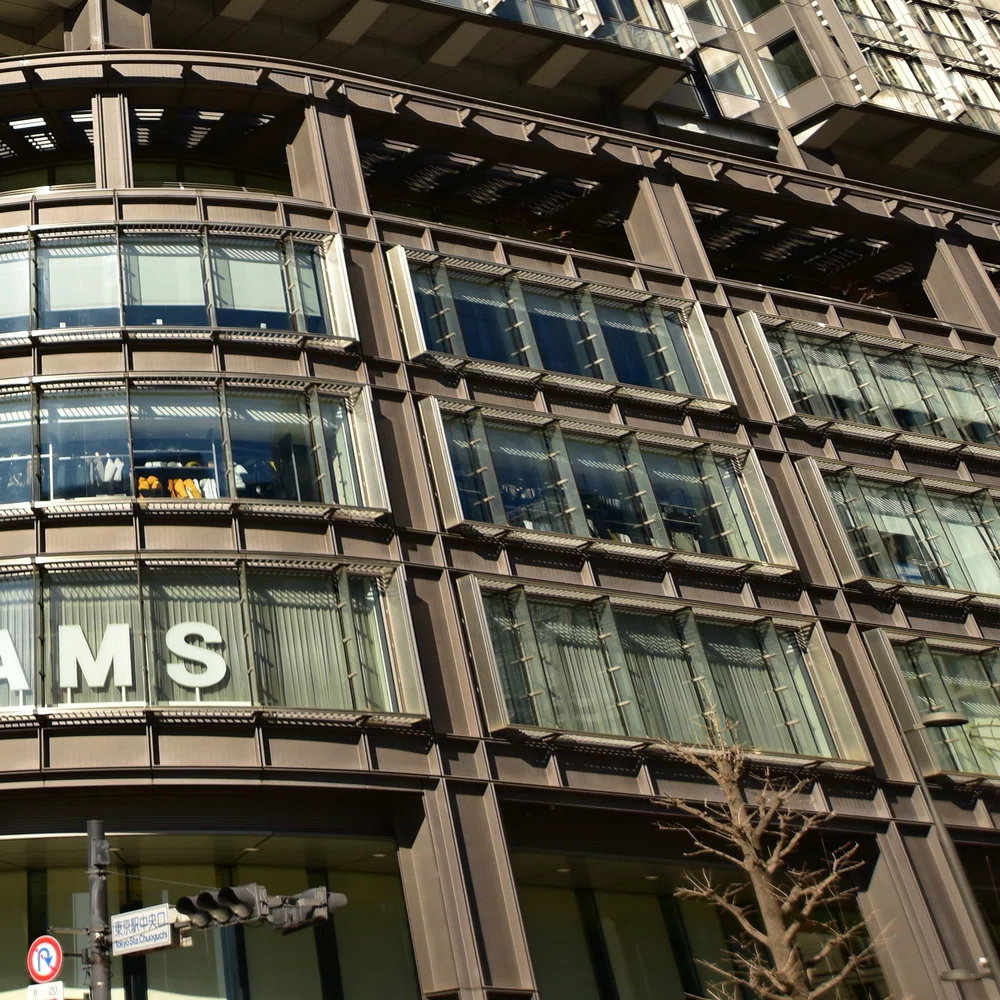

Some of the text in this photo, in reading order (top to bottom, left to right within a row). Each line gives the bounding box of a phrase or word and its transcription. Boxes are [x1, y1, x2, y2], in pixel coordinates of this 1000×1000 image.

[115, 912, 165, 937] 東京駅中央口
[115, 939, 129, 949] Tokyo
